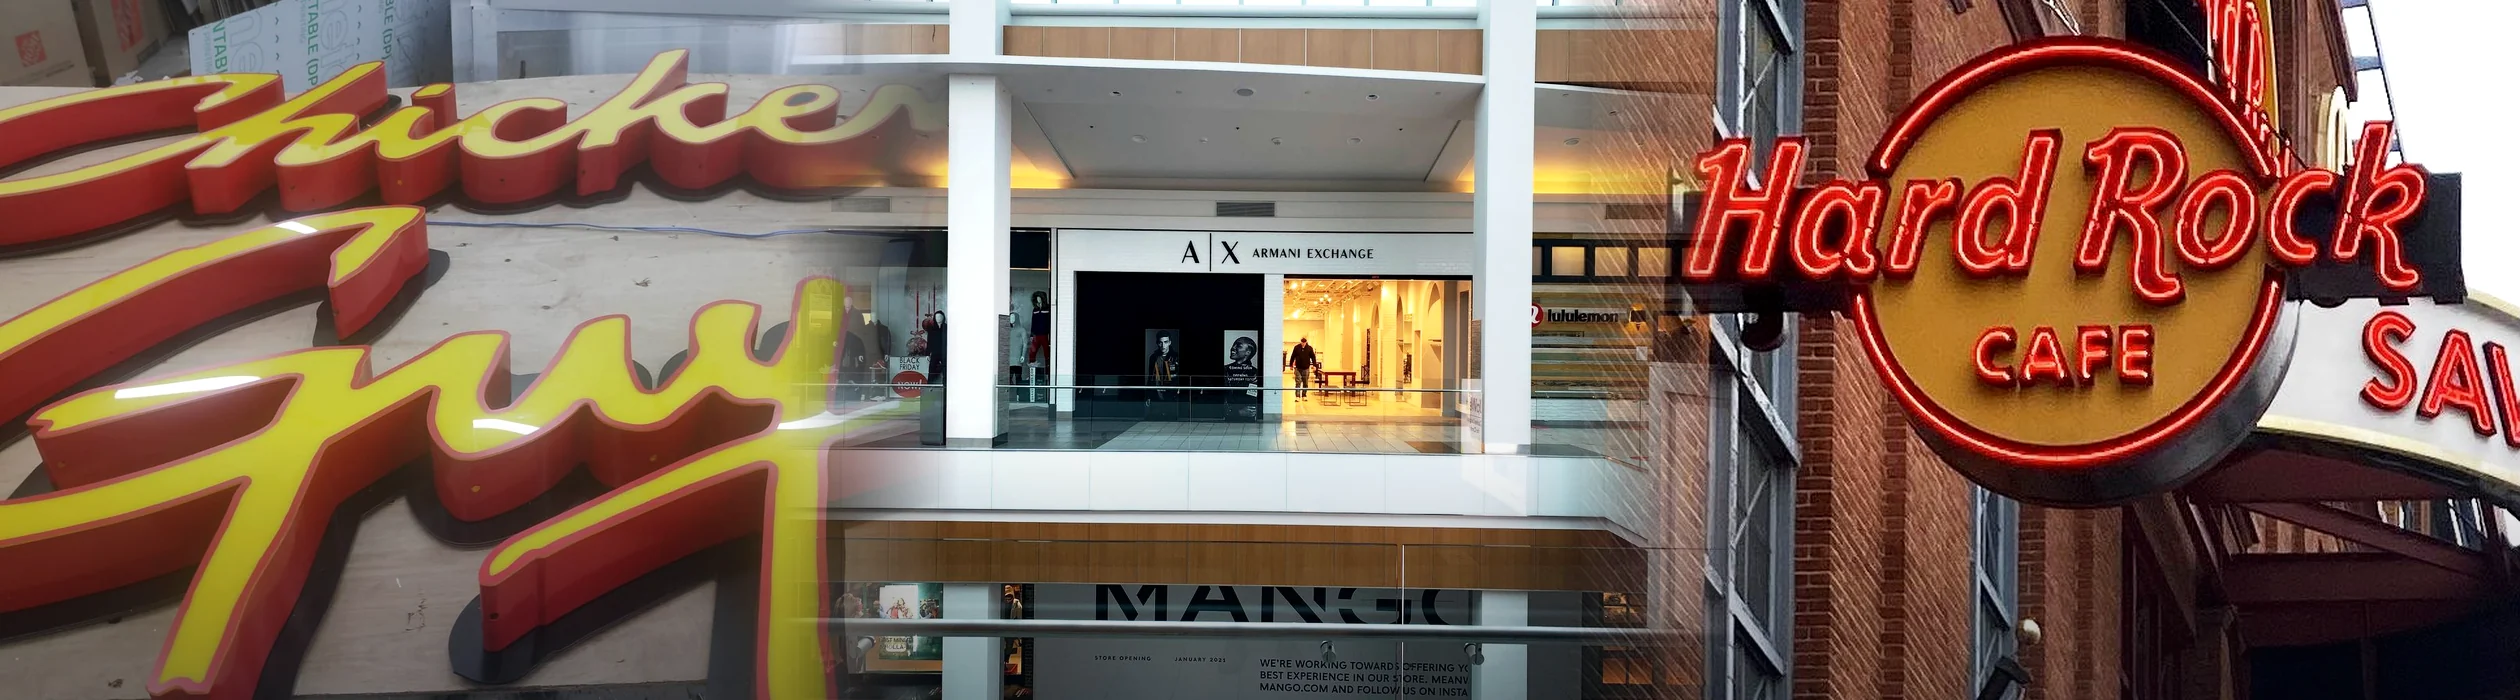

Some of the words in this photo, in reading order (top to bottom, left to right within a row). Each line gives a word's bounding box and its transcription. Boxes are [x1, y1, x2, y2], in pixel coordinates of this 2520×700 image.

[1683, 128, 2062, 281] Hard
[2074, 121, 2427, 306] Rock
[1252, 248, 1301, 259] ARMANI
[1307, 248, 1374, 259] EXCHANGE
[1547, 309, 1618, 323] lululemon
[1972, 325, 2157, 388] CAFE
[0, 206, 880, 700] Guy
[1260, 659, 1292, 668] WE'RE
[1295, 660, 1347, 670] WORKING
[1350, 661, 1400, 671] TOWARDS
[1402, 662, 1455, 673] OFFERING
[1260, 671, 1284, 680] BEST
[1287, 672, 1350, 682] EXPERIENCE
[1353, 673, 1365, 682] IN
[1368, 674, 1390, 683] OUR
[1393, 674, 1428, 684] STORE.
[1260, 683, 1329, 693] MANGO.COM
[1332, 684, 1354, 694] AND
[1357, 685, 1400, 695] FOLLOW
[1402, 686, 1416, 696] US
[1419, 687, 1436, 696] ON
